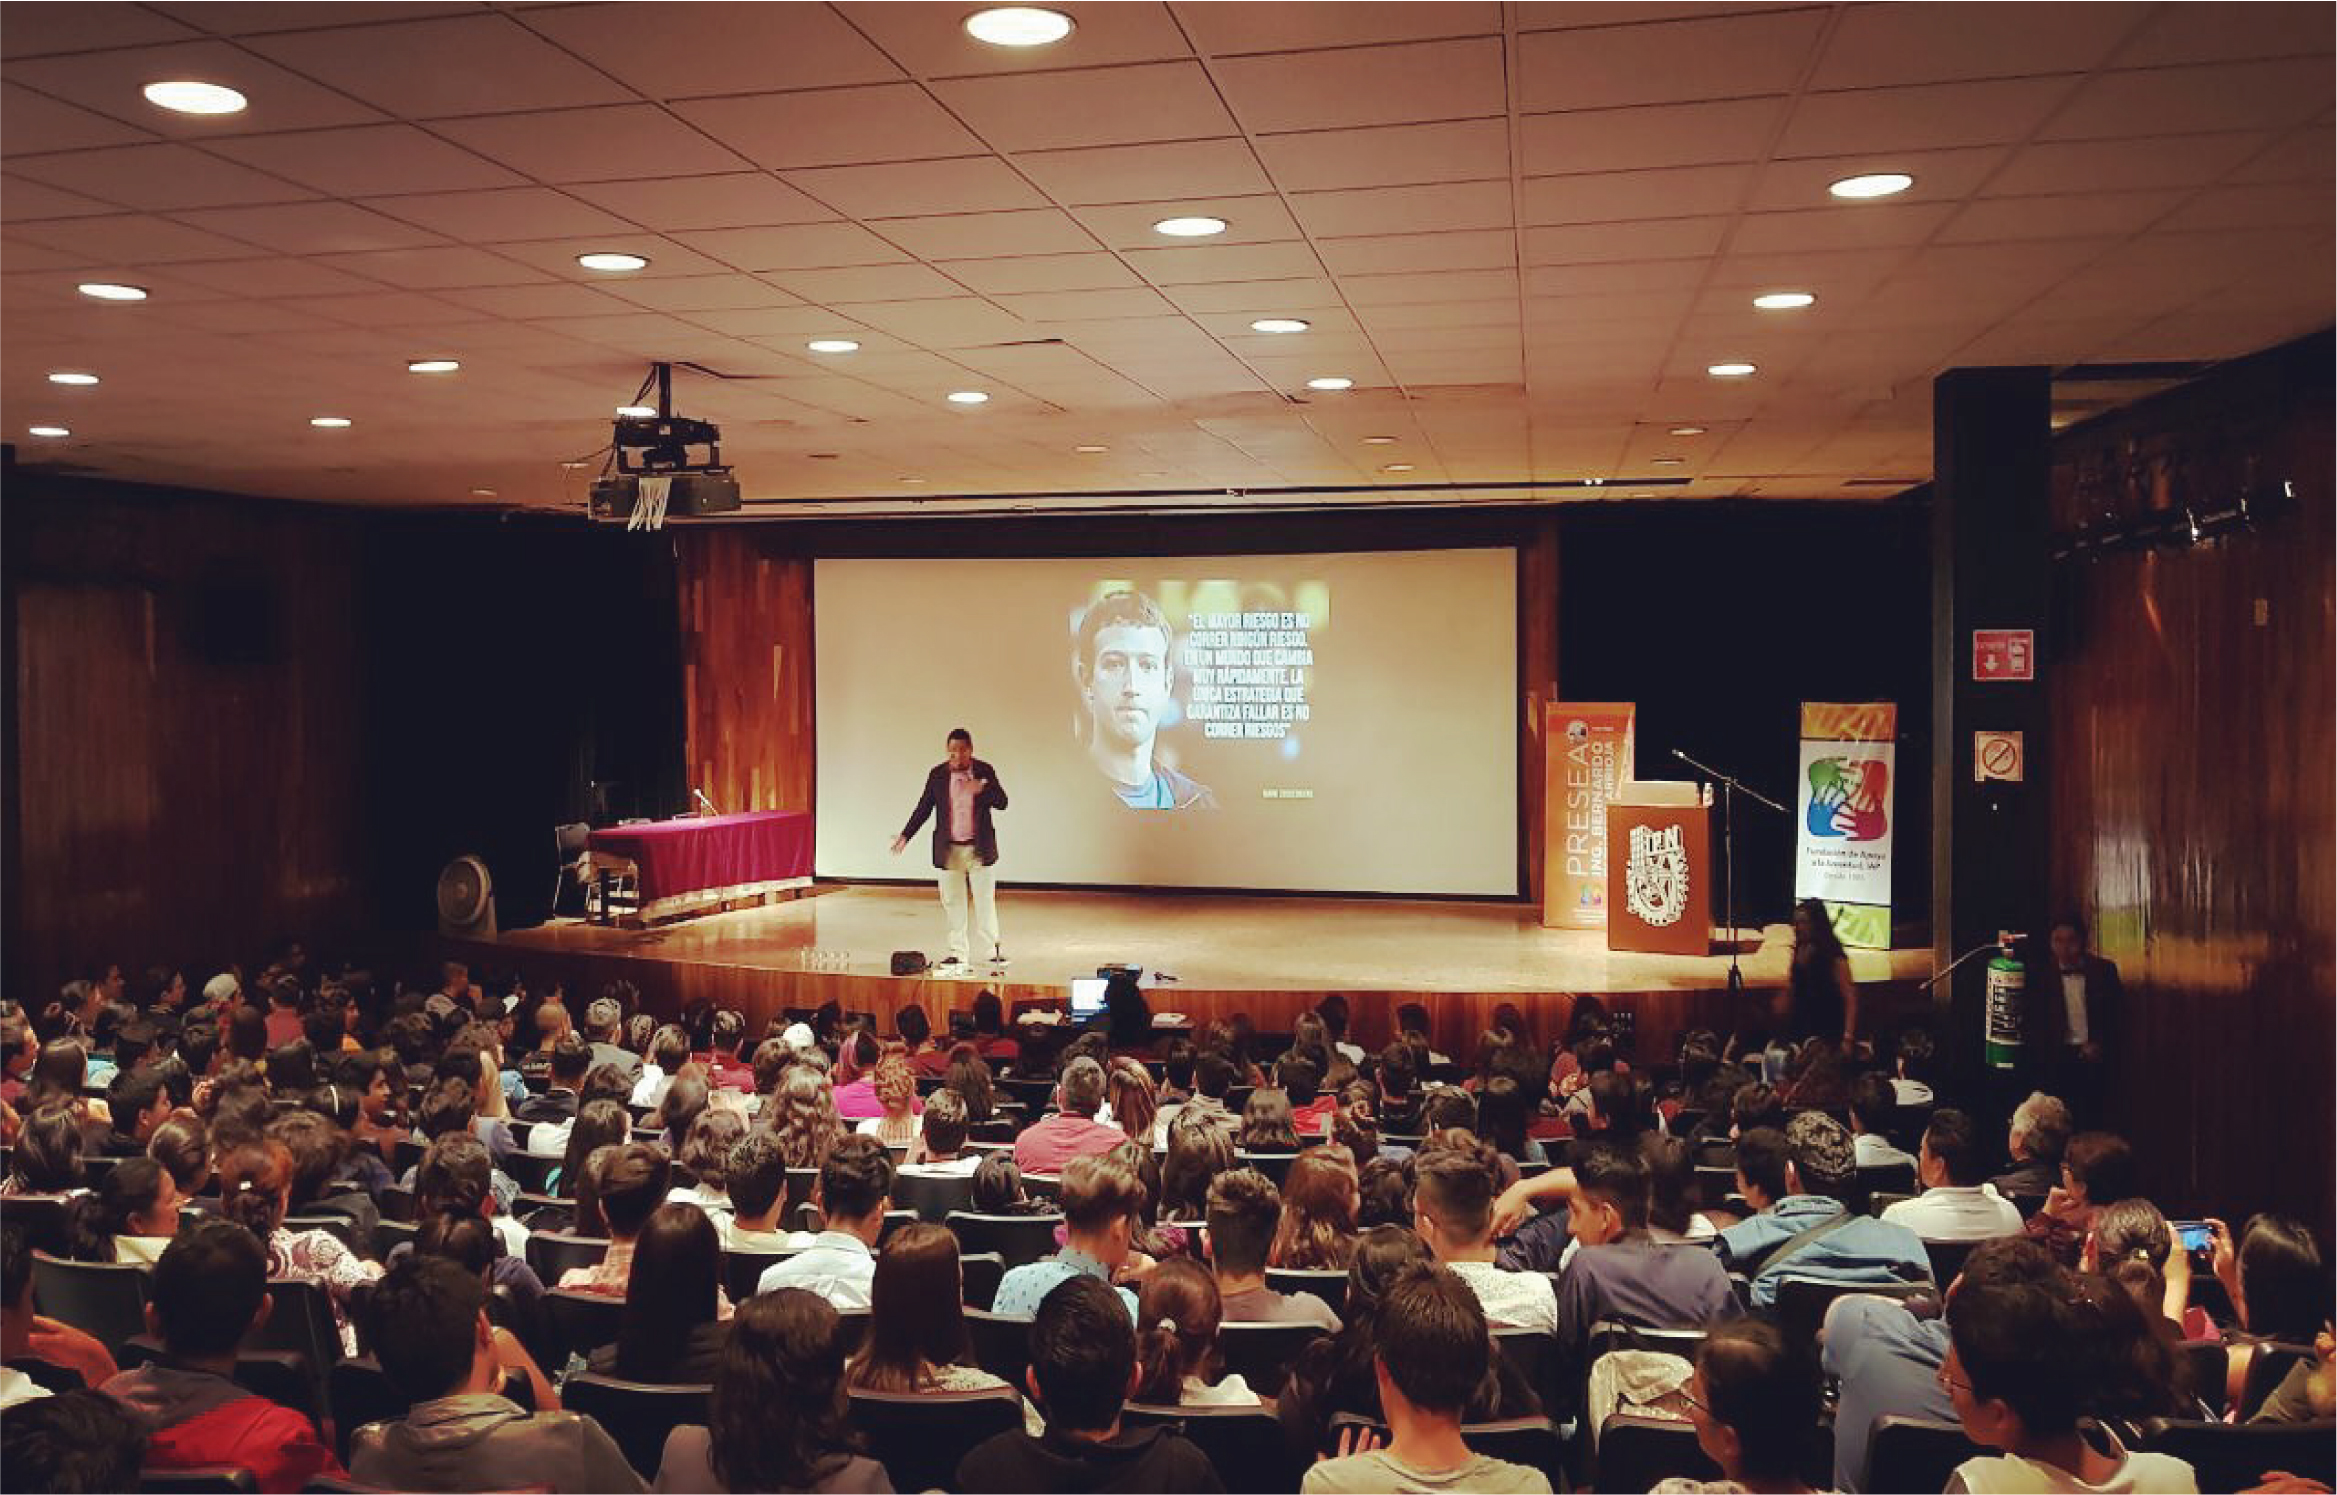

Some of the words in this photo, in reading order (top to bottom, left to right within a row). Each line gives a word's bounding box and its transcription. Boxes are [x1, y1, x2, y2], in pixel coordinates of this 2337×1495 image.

[1281, 613, 1293, 628] ES
[1296, 613, 1310, 628] NO
[1591, 741, 1604, 836] BERNARDO
[1604, 740, 1614, 800] ARRIOJA
[1567, 743, 1589, 876] PRESEA
